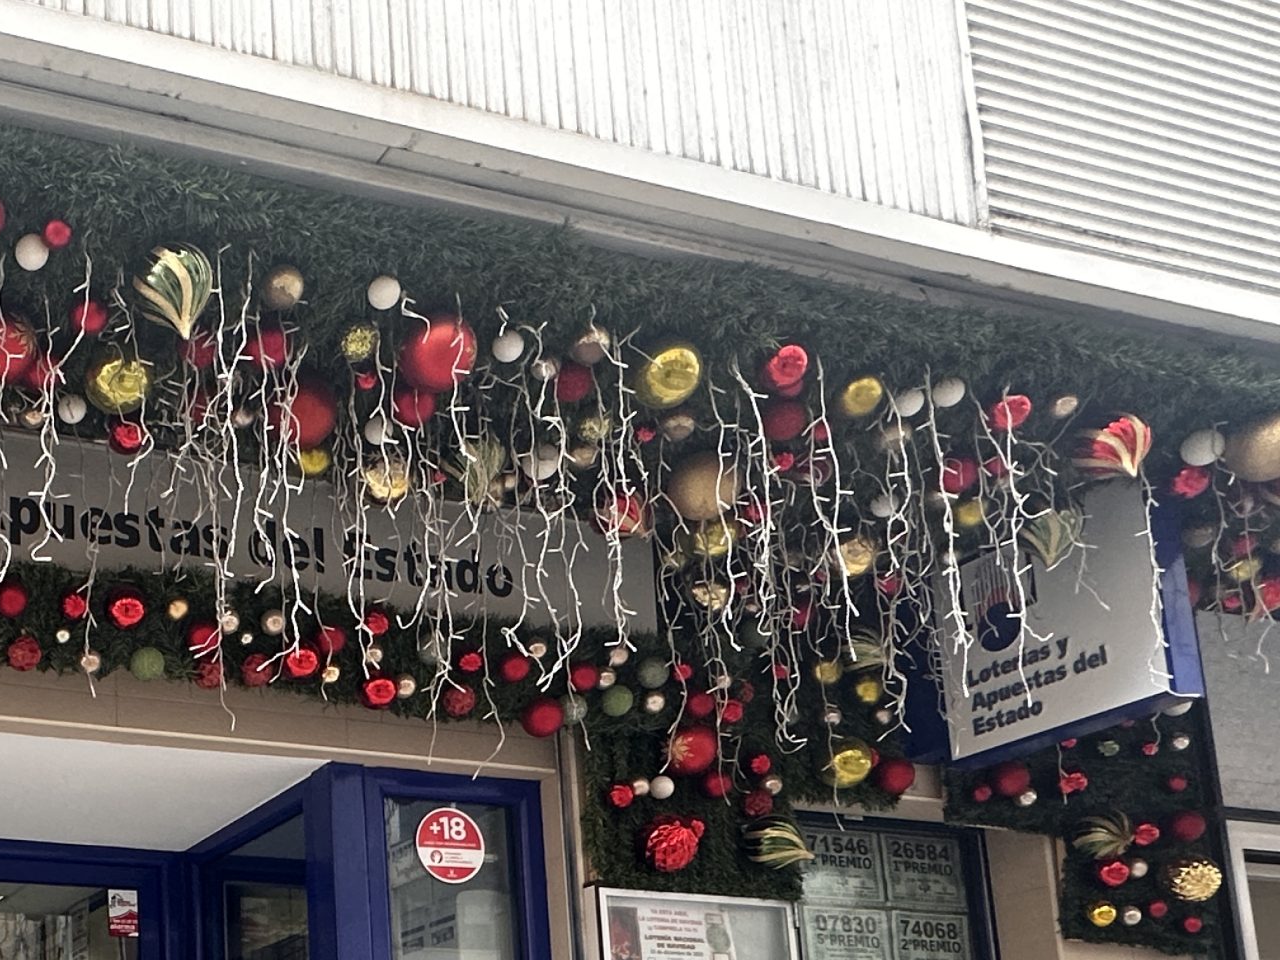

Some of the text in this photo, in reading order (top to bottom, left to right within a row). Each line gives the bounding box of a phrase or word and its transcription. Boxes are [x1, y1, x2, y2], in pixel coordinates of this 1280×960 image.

[248, 518, 325, 574] del
[1056, 636, 1069, 660] y
[971, 644, 1108, 712] Apuestas del
[972, 699, 1043, 737] Estado
[429, 816, 467, 841] +18
[806, 834, 868, 856] 71546
[891, 841, 950, 861] 26584
[822, 854, 872, 870] PREMIO
[904, 861, 953, 877] PREMIO
[815, 914, 877, 934] 07830
[900, 919, 959, 941] 74068
[830, 934, 880, 949] PREMIO
[913, 939, 962, 953] PREMIO
